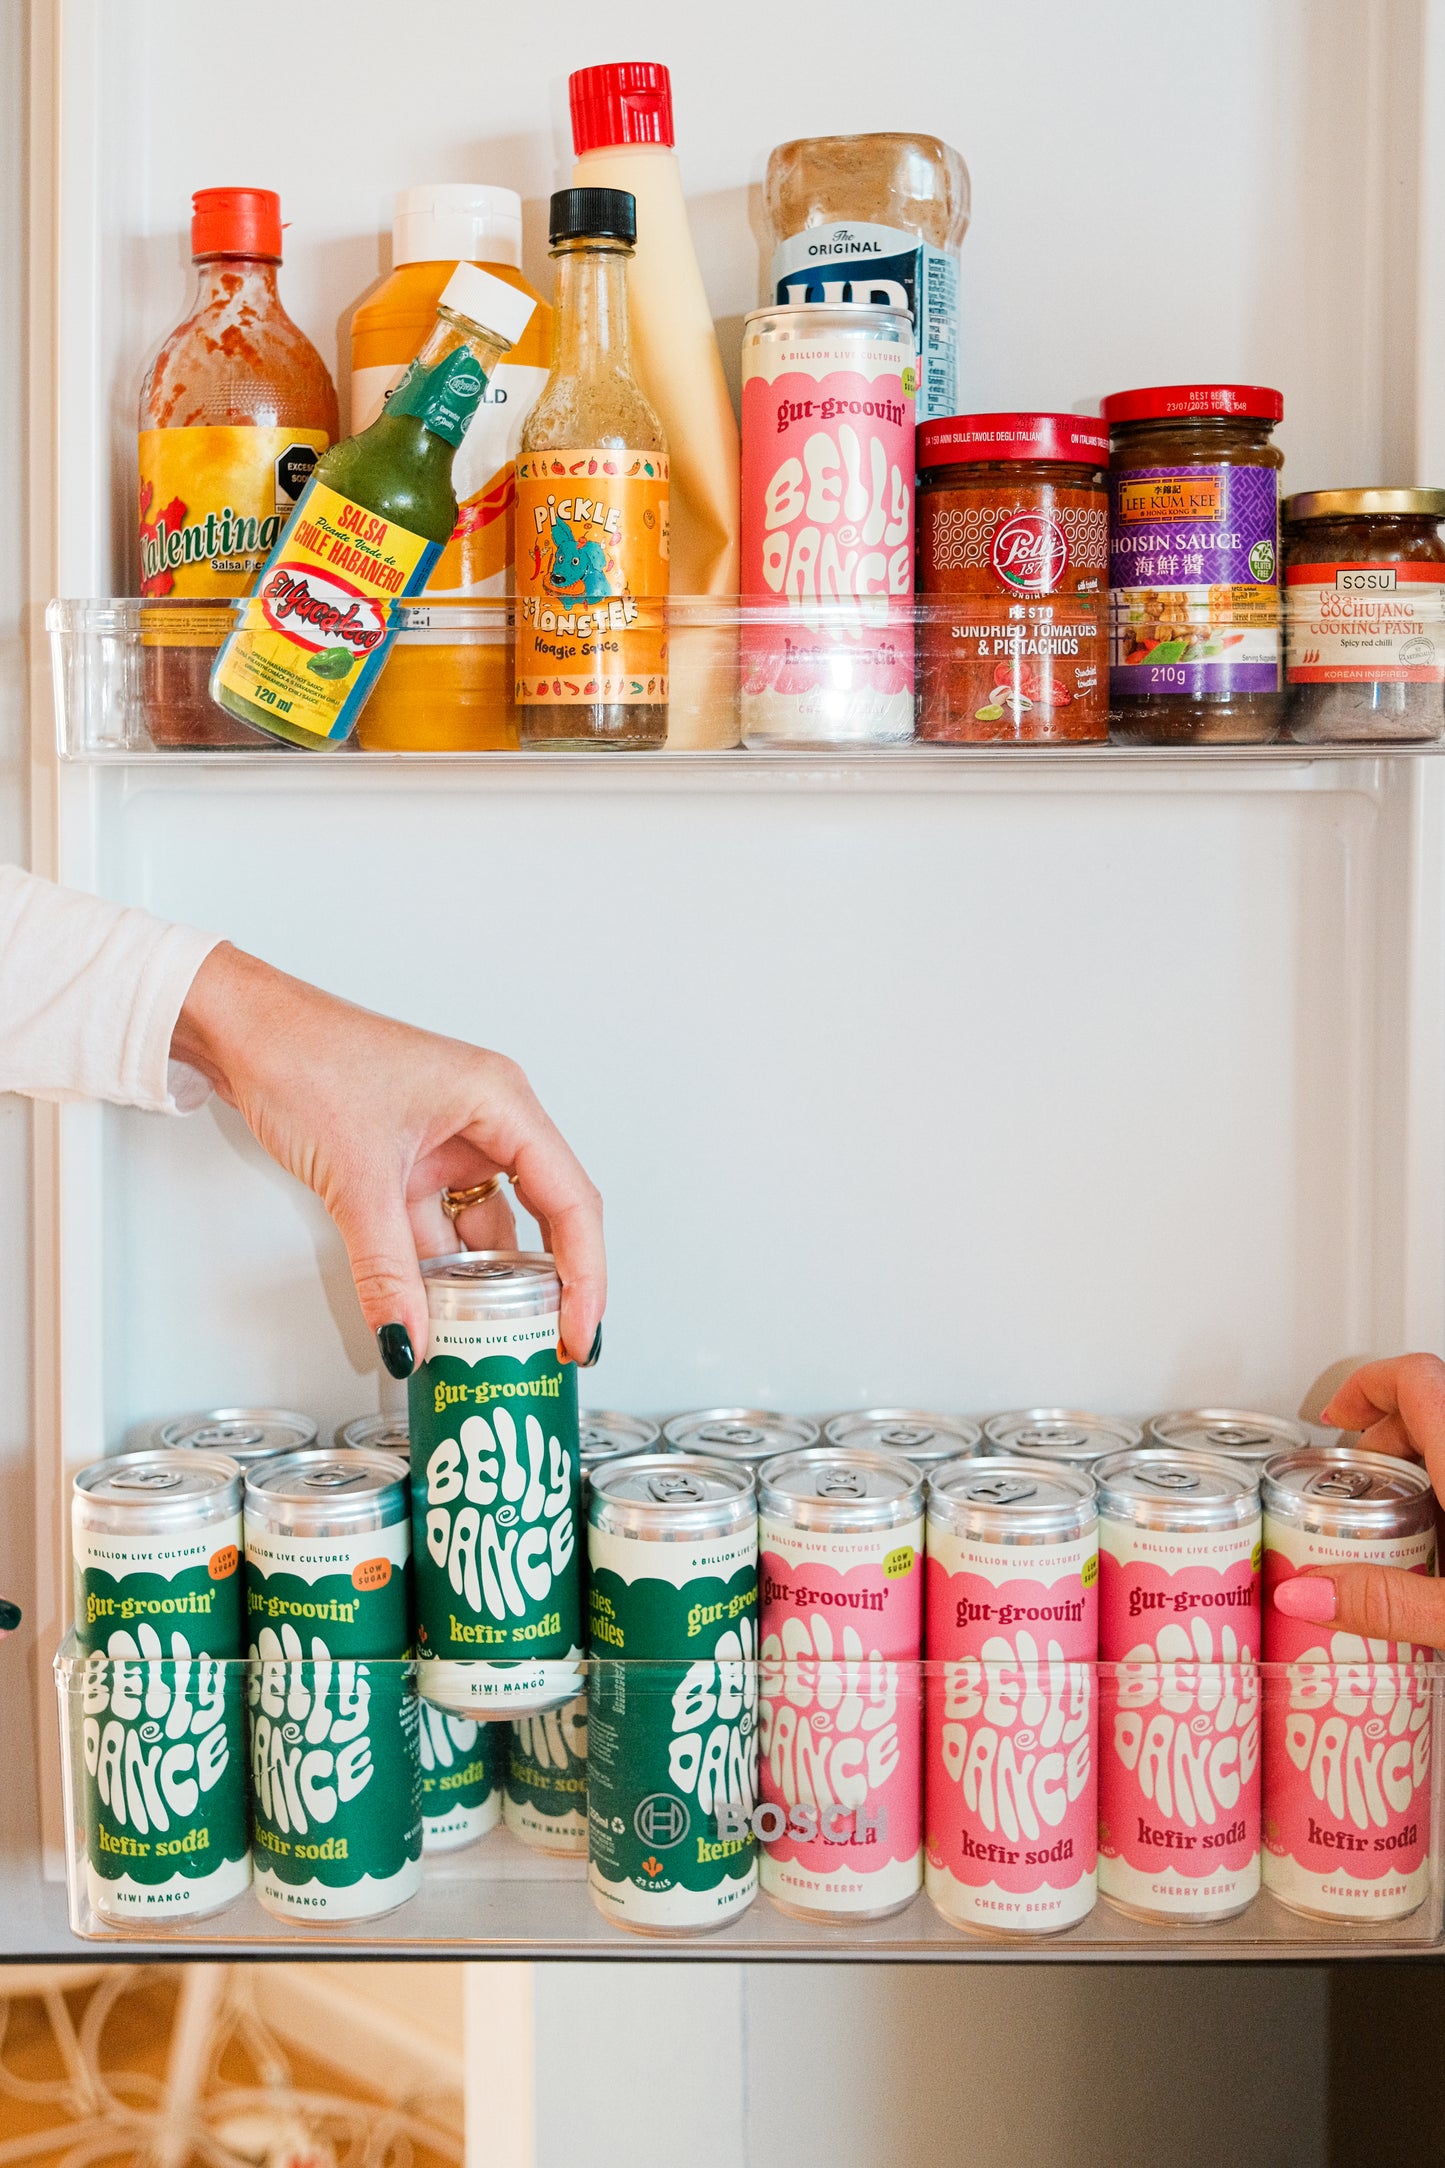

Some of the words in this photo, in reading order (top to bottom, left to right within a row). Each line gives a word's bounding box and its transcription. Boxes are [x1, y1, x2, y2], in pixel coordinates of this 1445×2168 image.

[832, 230, 855, 242] The
[808, 241, 882, 256] ORIGINAL
[781, 353, 786, 361] 6
[790, 351, 830, 360] BILLION
[1189, 391, 1208, 401] BEST
[777, 398, 906, 433] gut-groovin'
[1167, 402, 1208, 412] 23/07/2025
[953, 433, 971, 443] SULLE
[971, 432, 995, 442] TAVOLE
[996, 432, 1015, 441] DEGLI
[765, 424, 910, 547] BELLY
[1126, 497, 1145, 511] LEE
[1151, 496, 1184, 509] KUM
[1190, 494, 1215, 507] KEE
[534, 494, 622, 534] PICKLE
[338, 504, 388, 547] SALSA
[315, 517, 351, 543] Picante
[354, 538, 382, 560] Verde
[384, 553, 397, 565] de
[1111, 535, 1170, 554] HOISIN
[1175, 533, 1242, 550] SAUCE
[211, 560, 241, 570] Salsa
[294, 520, 328, 557] CHILE
[327, 540, 405, 594] HABANERO
[1135, 554, 1204, 577] 海鮮醬
[1254, 561, 1272, 570] GLUTEN
[763, 526, 910, 640] DANCE
[1257, 570, 1269, 578] FREE
[1343, 575, 1390, 589] SOSU
[276, 579, 382, 649] Yucateco
[523, 595, 640, 639] MONSTER
[1320, 602, 1415, 620] GOCHUJANG
[951, 625, 1027, 638] SUNDRIED
[1032, 625, 1097, 638] TOMATOES
[1310, 622, 1380, 635] COOKING
[1385, 622, 1424, 635] PASTE
[534, 636, 577, 660] Hoagie
[581, 640, 619, 656] Sauce
[977, 640, 990, 655] &
[992, 639, 1078, 656] PISTACHIOS
[1340, 639, 1359, 648] Spicy
[1362, 638, 1373, 646] red
[1375, 638, 1393, 646] chilli
[1324, 670, 1363, 678] KOREAN
[1365, 670, 1408, 678] INSPIRED
[254, 686, 277, 704] 120
[277, 698, 293, 713] ml
[486, 1335, 508, 1344] LIVE
[512, 1328, 555, 1342] CULTURES
[434, 1372, 563, 1413] gut-groovin'
[426, 1407, 571, 1523] BELLY
[93, 1549, 127, 1560] BILLION
[131, 1552, 153, 1560] LIVE
[158, 1545, 207, 1560] CULTURES
[771, 1534, 802, 1549] BILLION
[806, 1542, 827, 1552] LIVE
[831, 1543, 881, 1553] CULTURES
[1133, 1541, 1138, 1549] 6
[1142, 1543, 1182, 1554] BILLION
[1187, 1546, 1208, 1554] LIVE
[1318, 1546, 1359, 1558] BILLION
[1364, 1551, 1385, 1559] LIVE
[213, 1558, 236, 1574] SUGAR
[218, 1551, 233, 1564] LOW
[276, 1553, 296, 1562] LIVE
[300, 1554, 350, 1563] CULTURES
[426, 1507, 575, 1620] DANCE
[702, 1553, 735, 1566] BILLION
[888, 1561, 912, 1574] SUGAR
[892, 1553, 908, 1563] LOW
[968, 1554, 1008, 1566] BILLION
[1012, 1559, 1034, 1567] LIVE
[1039, 1553, 1081, 1567] CULTURES
[358, 1572, 387, 1585] SUGAR
[363, 1564, 383, 1575] LOW
[764, 1576, 889, 1611] gut-groovin'
[1129, 1580, 1255, 1616] gut-groovin'
[86, 1588, 216, 1623] gut-groovin'
[956, 1597, 1085, 1627] gut-groovin'
[449, 1614, 507, 1643] kefir
[512, 1613, 561, 1642] soda
[83, 1622, 227, 1739] BELLY
[759, 1613, 898, 1732] BELLY
[1115, 1616, 1258, 1732] BELLY
[250, 1623, 372, 1744] BELLY
[471, 1683, 498, 1692] KIWI
[504, 1678, 545, 1692] MANGO
[943, 1630, 1091, 1747] BELLY
[760, 1699, 900, 1822] DANCE
[1114, 1711, 1259, 1827] DANCE
[83, 1717, 230, 1835] DANCE
[439, 1761, 485, 1791] soda
[1285, 1713, 1431, 1830] DANCE
[942, 1723, 1091, 1842] DANCE
[431, 1820, 469, 1834] MANGO
[716, 1802, 888, 1843] BOSCH
[99, 1824, 151, 1857] kefir
[155, 1828, 210, 1857] soda
[1137, 1817, 1197, 1849] kefir
[1202, 1820, 1247, 1849] soda
[1308, 1817, 1368, 1851] kefir
[1374, 1824, 1417, 1851] soda
[294, 1837, 349, 1860] soda
[961, 1830, 1020, 1865] kefir
[1025, 1838, 1074, 1865] soda
[636, 1876, 646, 1887] 23
[648, 1878, 672, 1890] CALS
[780, 1873, 820, 1890] CHERRY
[826, 1883, 863, 1893] BERRY
[1152, 1884, 1198, 1896] CHERRY
[1204, 1882, 1237, 1896] BERRY
[1321, 1884, 1369, 1898] CHERRY
[1374, 1884, 1407, 1897] BERRY
[117, 1892, 141, 1903] KIWI
[147, 1891, 190, 1903] MANGO
[265, 1886, 284, 1901] KIWI
[287, 1893, 327, 1907] MANGO
[717, 1892, 738, 1906] KIWI
[975, 1898, 1021, 1912] CHERRY
[1026, 1900, 1062, 1912] BERRY
